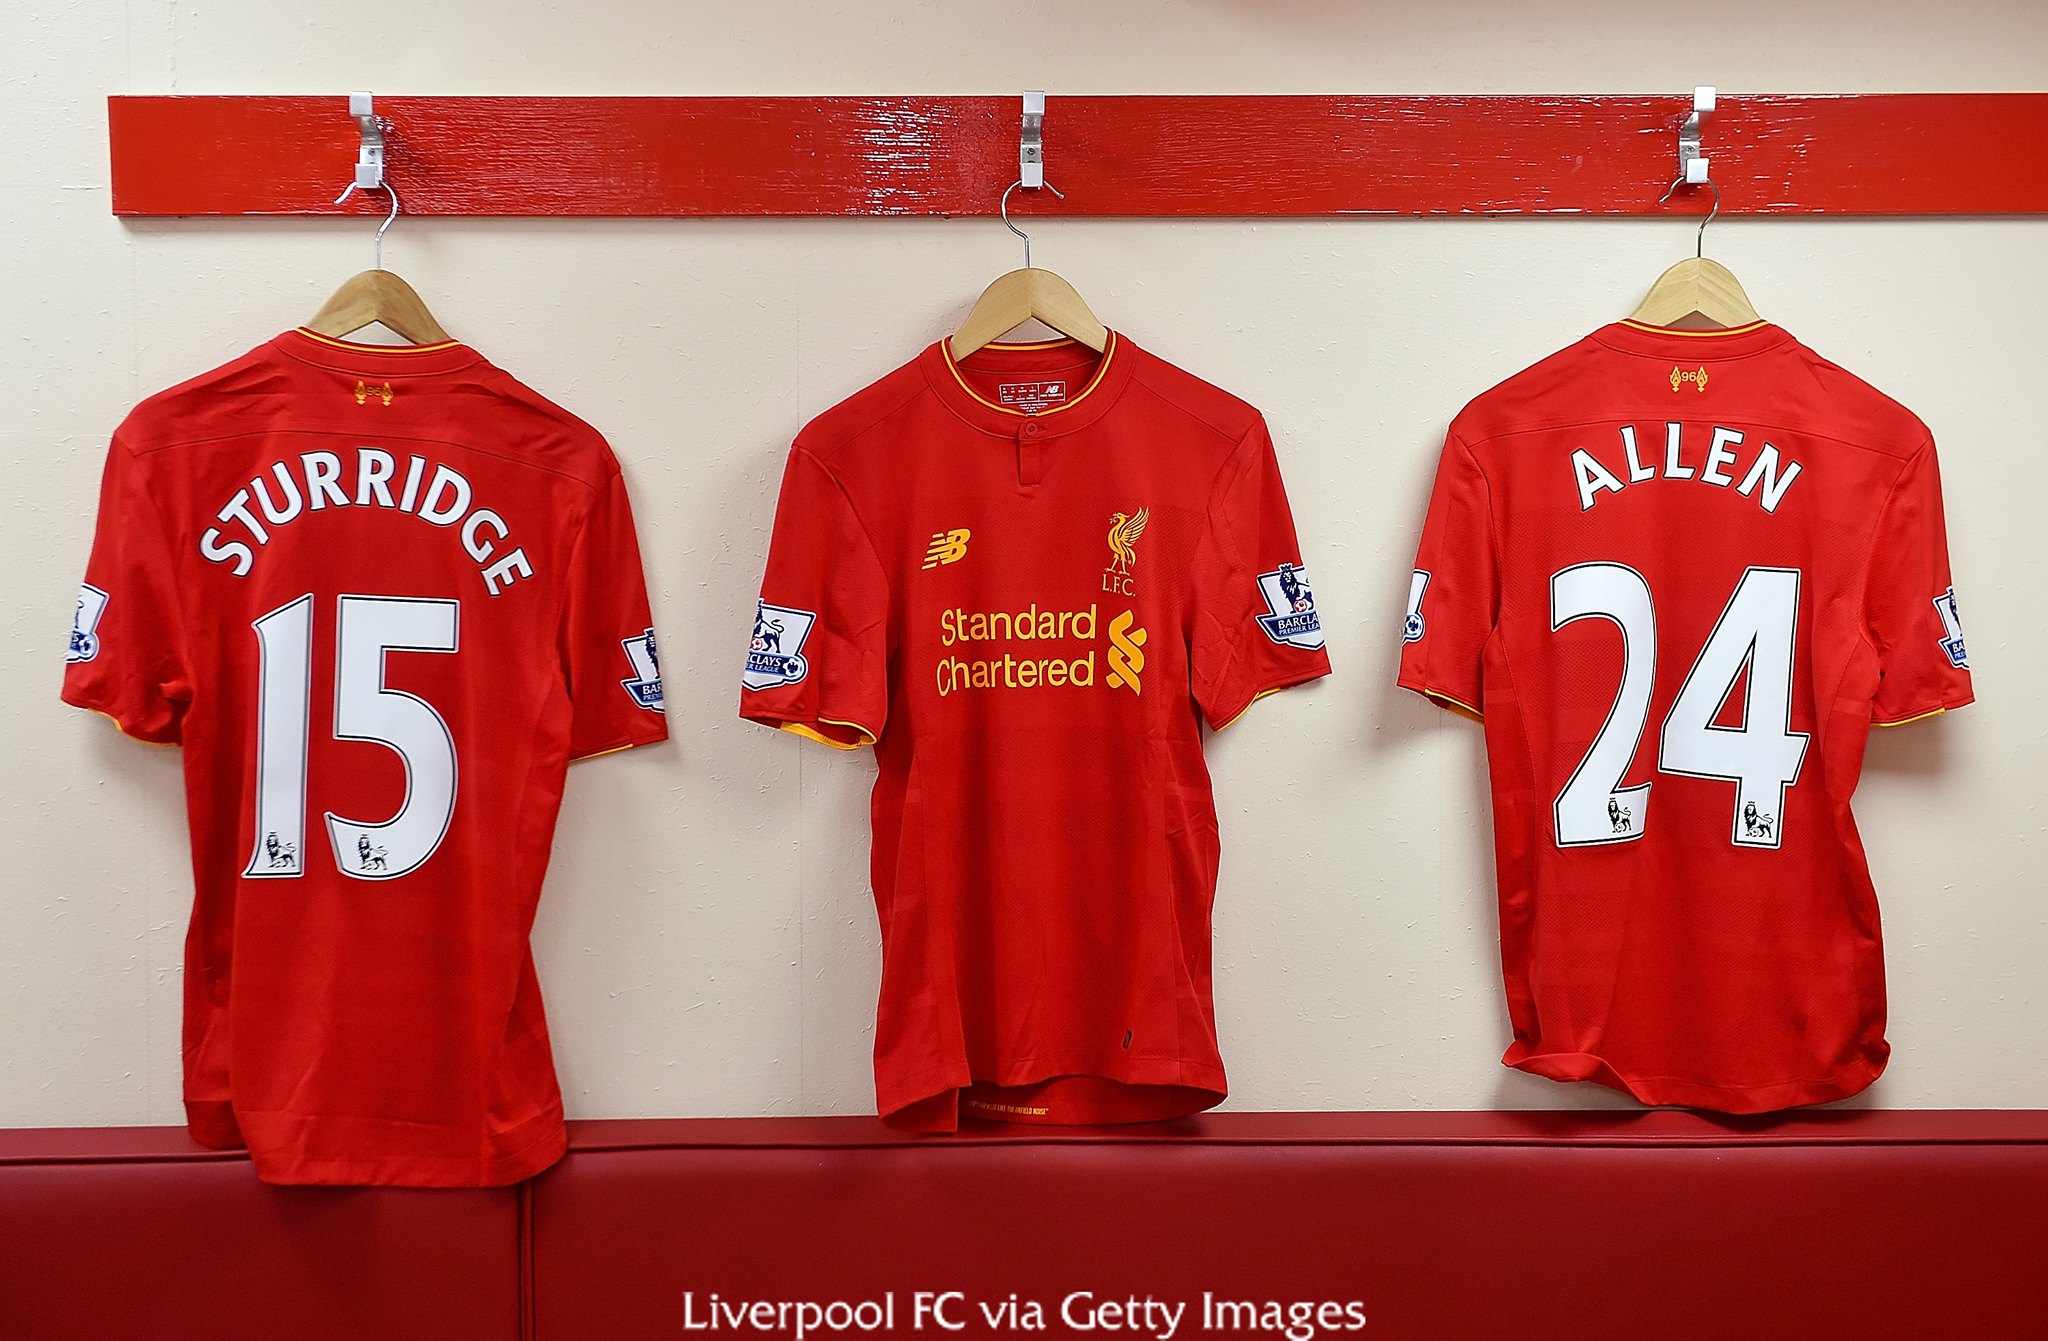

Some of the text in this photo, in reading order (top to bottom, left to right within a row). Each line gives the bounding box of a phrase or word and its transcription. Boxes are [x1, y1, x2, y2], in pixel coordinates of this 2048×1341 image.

[1681, 371, 1697, 382] 96
[1570, 421, 1804, 514] ALLEN
[200, 448, 534, 597] STURRIDGE
[1102, 574, 1136, 597] L.F.C.
[941, 604, 1097, 646] Standard
[937, 651, 1095, 697] Chartered
[1551, 561, 1811, 850] 24
[241, 593, 460, 881] 15
